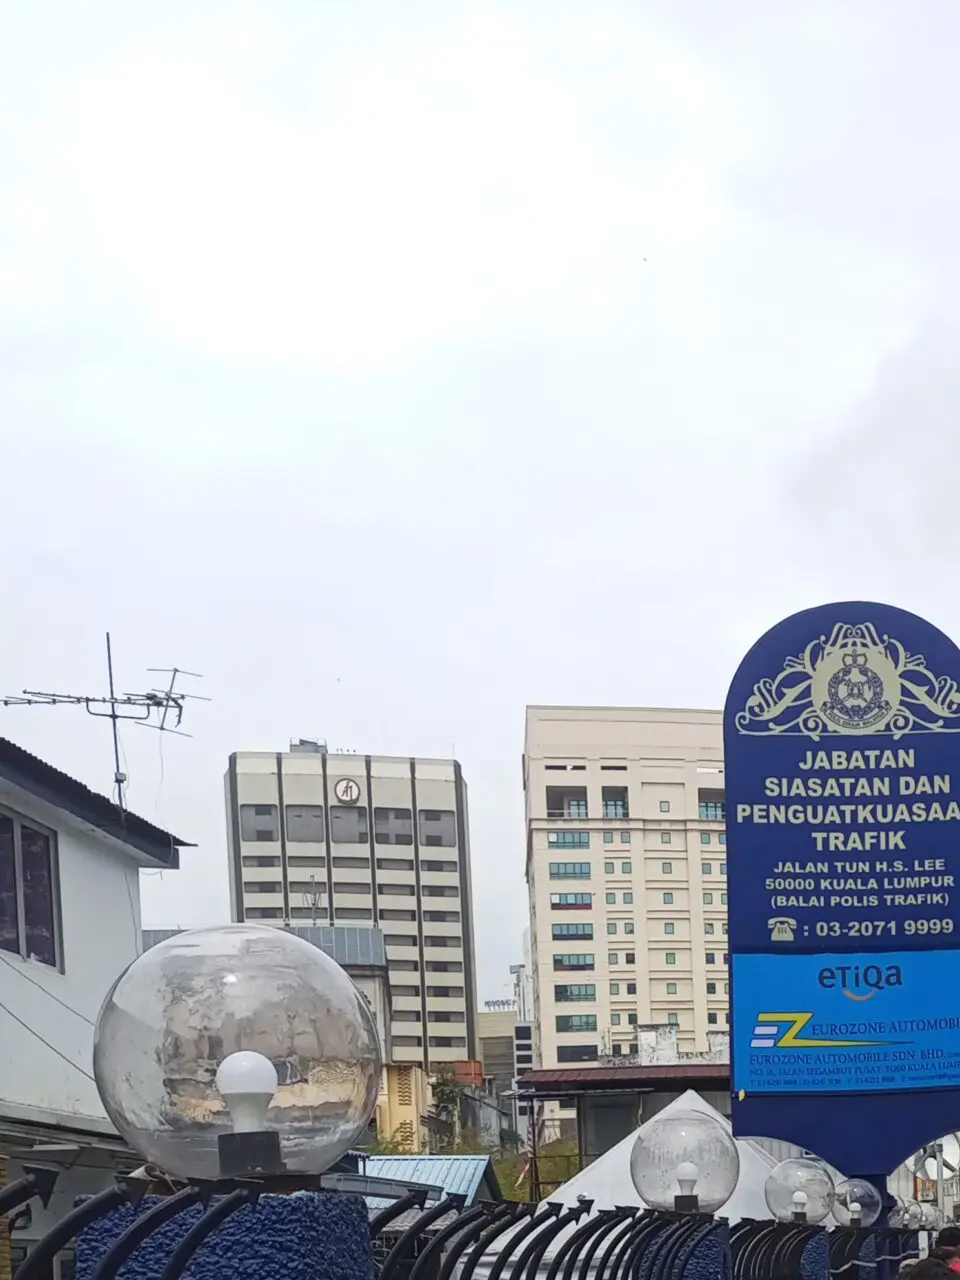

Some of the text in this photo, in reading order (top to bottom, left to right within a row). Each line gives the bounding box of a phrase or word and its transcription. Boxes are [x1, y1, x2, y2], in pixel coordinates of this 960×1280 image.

[799, 749, 915, 770] JABATAN
[764, 775, 950, 797] SIASATAN DAN
[811, 831, 907, 851] TRAFIK
[773, 859, 946, 874] JALAN TUN H.S. LEE
[765, 876, 955, 890] 50000 KUALA LUMPUR
[771, 893, 950, 907] (BALAI POLIS TRAFIK)
[815, 921, 897, 937] 03-2071
[904, 919, 955, 935] 9999
[811, 1021, 887, 1036] EUROZONE
[750, 1054, 812, 1065] EUROZONE
[814, 1052, 891, 1064] AUTOMOBILE
